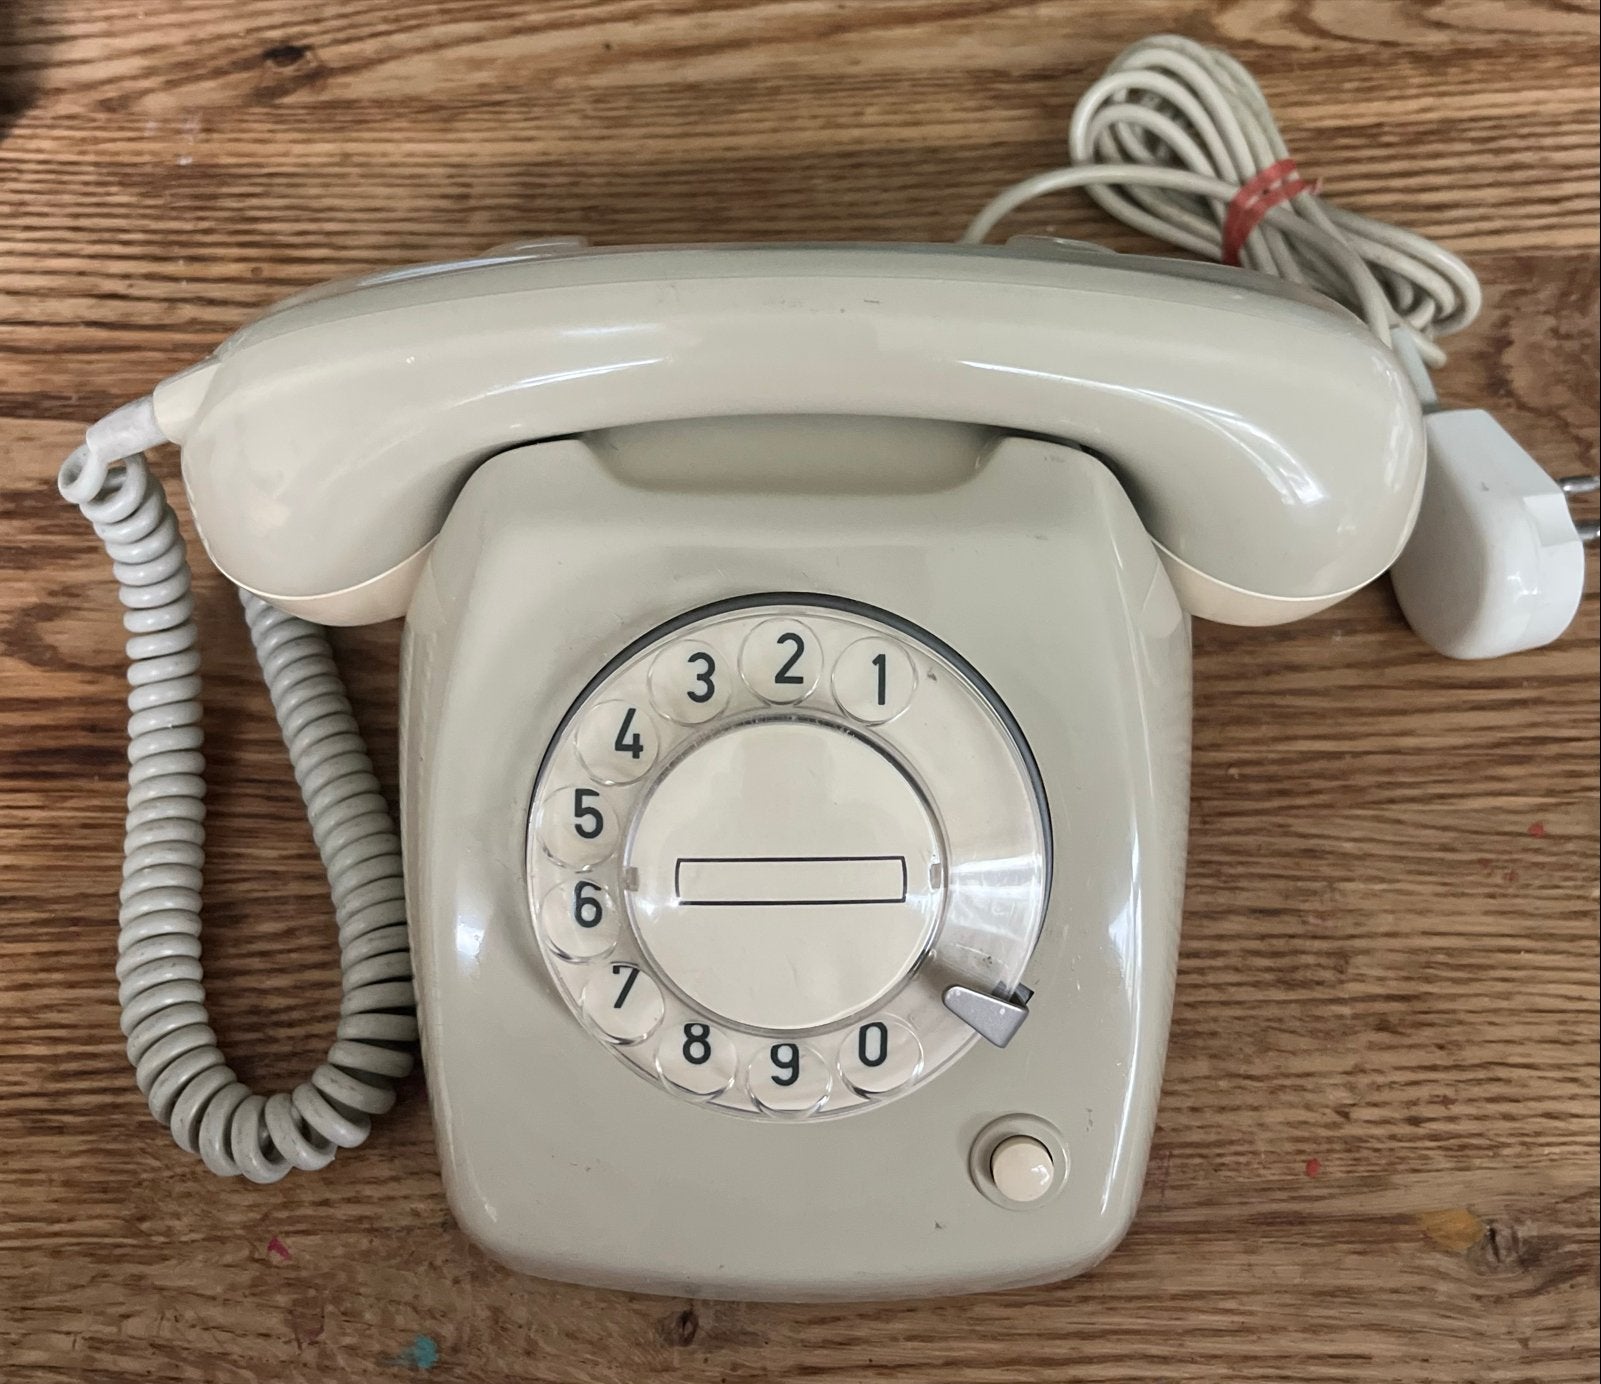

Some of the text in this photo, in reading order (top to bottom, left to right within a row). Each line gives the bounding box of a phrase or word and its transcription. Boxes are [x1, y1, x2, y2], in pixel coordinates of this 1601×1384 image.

[686, 651, 716, 704] 3
[775, 632, 805, 685] 2
[871, 653, 886, 706] 1
[614, 707, 644, 760] 4
[574, 788, 604, 840] 5
[574, 880, 603, 929] 6
[611, 964, 642, 1009] 7
[682, 1022, 712, 1065] 8
[770, 1042, 800, 1087] 9
[858, 1021, 888, 1068] 0
